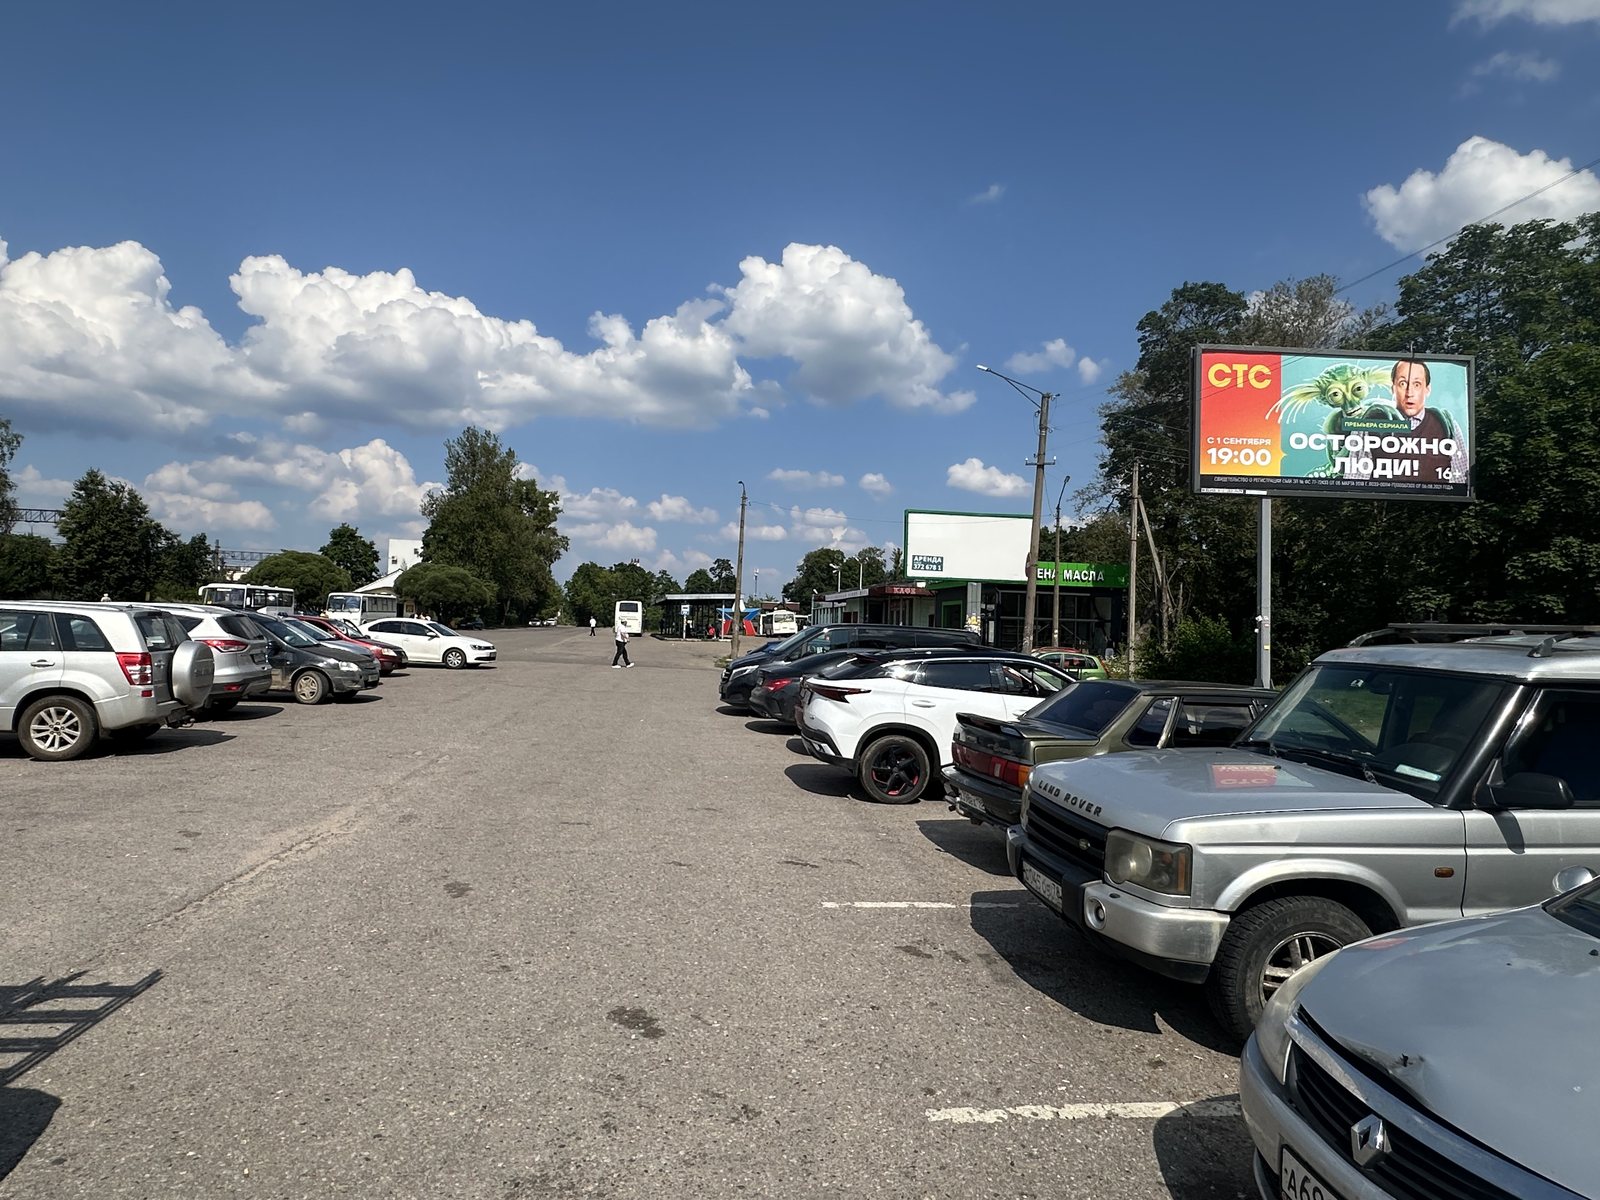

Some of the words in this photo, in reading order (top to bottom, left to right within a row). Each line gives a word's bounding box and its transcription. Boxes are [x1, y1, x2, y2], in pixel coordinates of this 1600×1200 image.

[1208, 363, 1272, 389] СТС
[1223, 437, 1271, 446] СЕНТЯБРЯ
[1289, 432, 1462, 458] ОСТОРОЖНО,
[1207, 447, 1272, 466] 19:00
[1333, 457, 1420, 479] ЛЮДИ!
[1435, 467, 1461, 480] 16+
[913, 555, 942, 563] АРЕНДА
[1063, 569, 1104, 581] МАСЛА
[1038, 780, 1061, 797] LAND
[1063, 792, 1102, 817] ROVER
